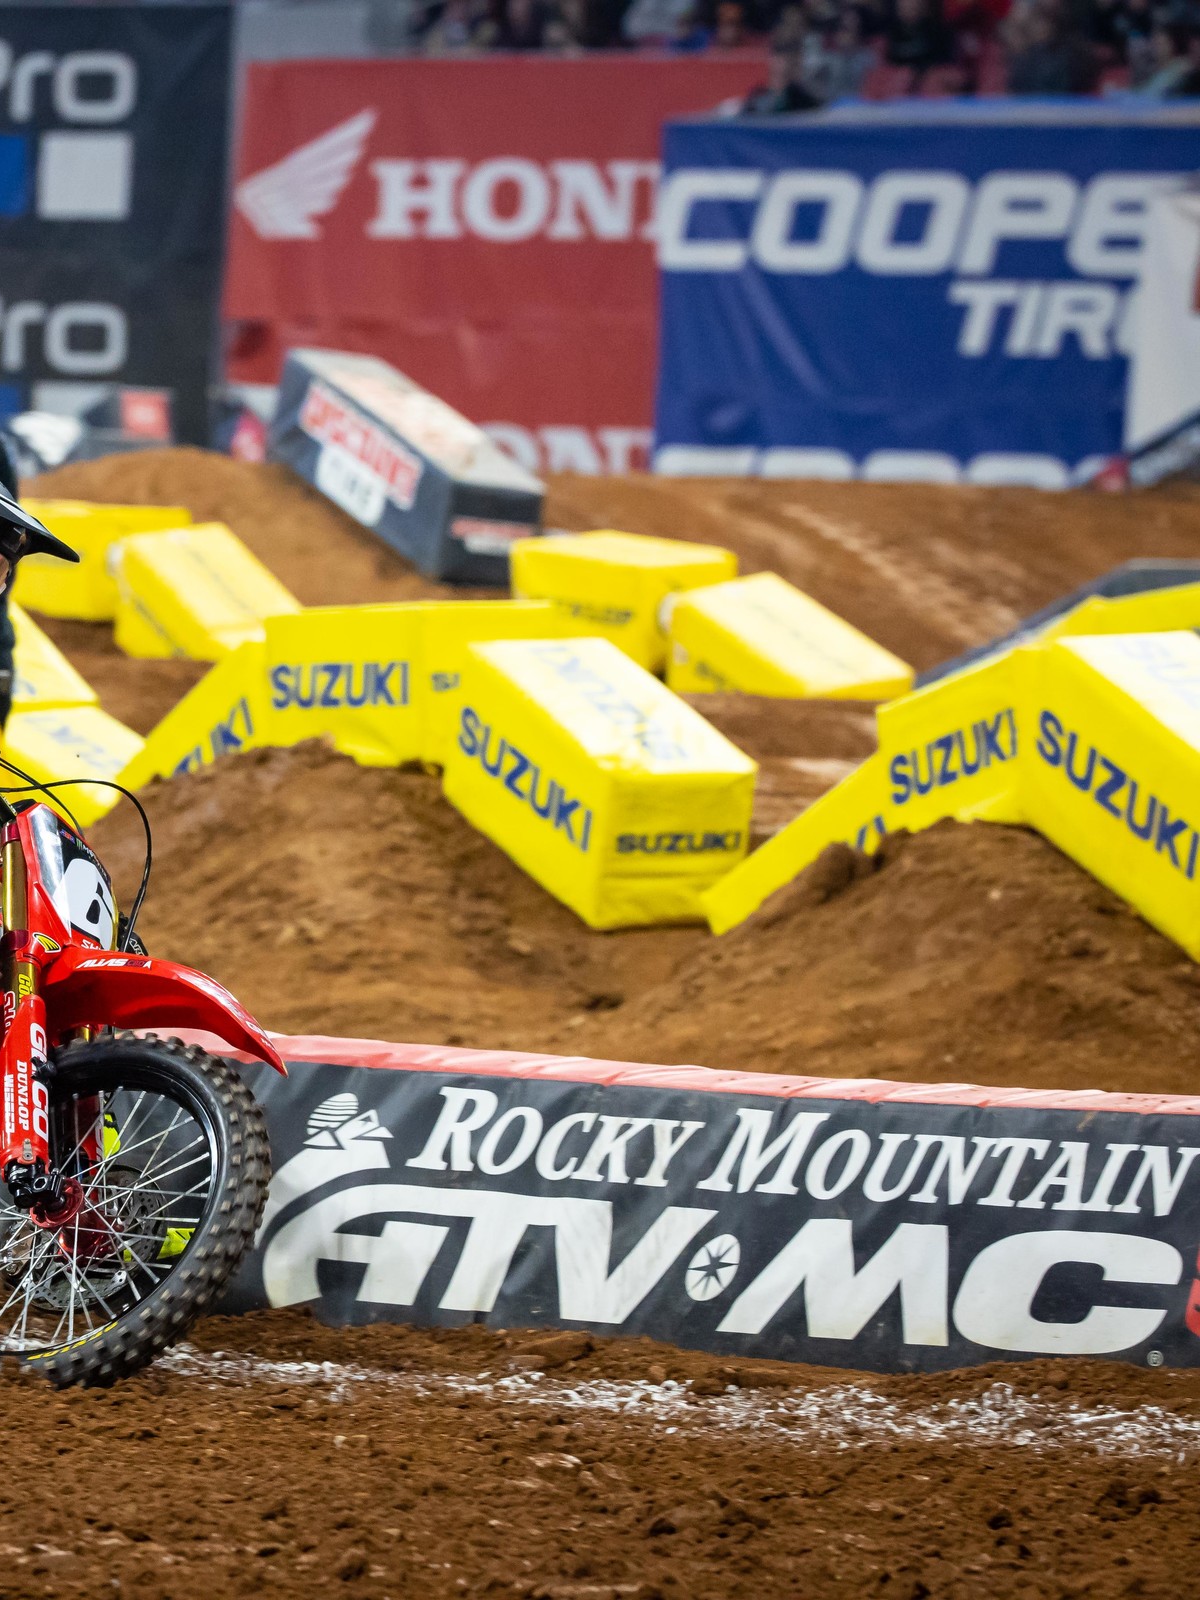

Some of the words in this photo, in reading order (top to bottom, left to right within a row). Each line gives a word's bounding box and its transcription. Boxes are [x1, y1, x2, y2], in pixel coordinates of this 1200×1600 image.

[659, 169, 1175, 276] COOPE
[270, 661, 411, 710] SUZUKI
[458, 707, 593, 853] SUZUKI
[889, 707, 1019, 805] SUZUKI
[1036, 709, 1200, 880] SUZUKI
[615, 831, 742, 856] SUZUKI
[52, 858, 114, 951] 6
[16, 1059, 30, 1132] DUNLOP
[29, 1022, 49, 1143] GECO
[406, 1086, 705, 1188] ROCKY
[697, 1106, 1198, 1218] MOUNTAIN
